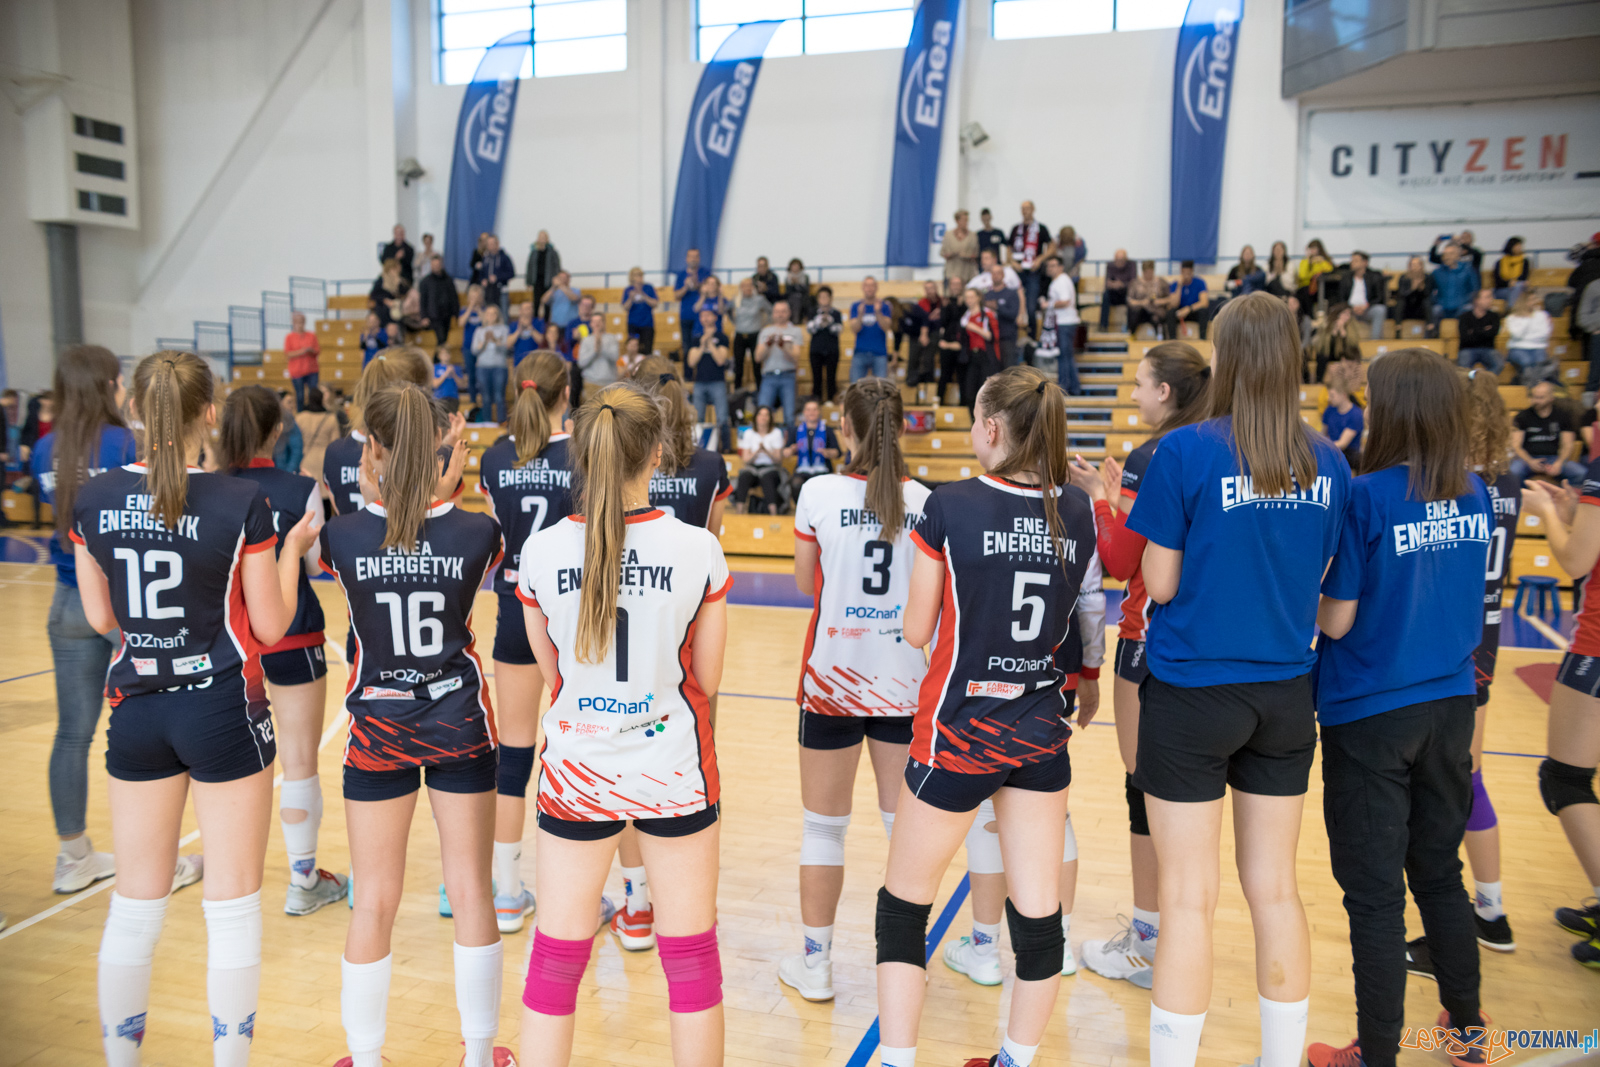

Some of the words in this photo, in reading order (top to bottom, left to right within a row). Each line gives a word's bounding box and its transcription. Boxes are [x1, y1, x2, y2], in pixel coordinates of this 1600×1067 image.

[915, 20, 952, 128] Enea
[1198, 7, 1236, 120] Enea
[706, 61, 756, 158] Enea
[1331, 133, 1569, 177] CITYZEN
[499, 469, 571, 489] ENERGETYK
[649, 478, 697, 496] RGETYK
[1221, 475, 1331, 508] ENEEYK
[99, 509, 200, 541] ENERGEYK
[841, 509, 917, 531] ENERYK
[1425, 500, 1459, 520] ENEA
[1393, 513, 1489, 552] ENERGETYK
[113, 548, 185, 619] 12
[355, 556, 464, 581] ENERGETYK
[557, 566, 673, 595] ENETYK
[862, 540, 893, 595] 3
[1011, 571, 1051, 642] 5
[375, 591, 445, 657] 16
[986, 682, 1024, 691] FABRYKA
[986, 687, 1014, 695] FORMY
[256, 717, 274, 744] 12
[576, 723, 610, 732] FABRYKA
